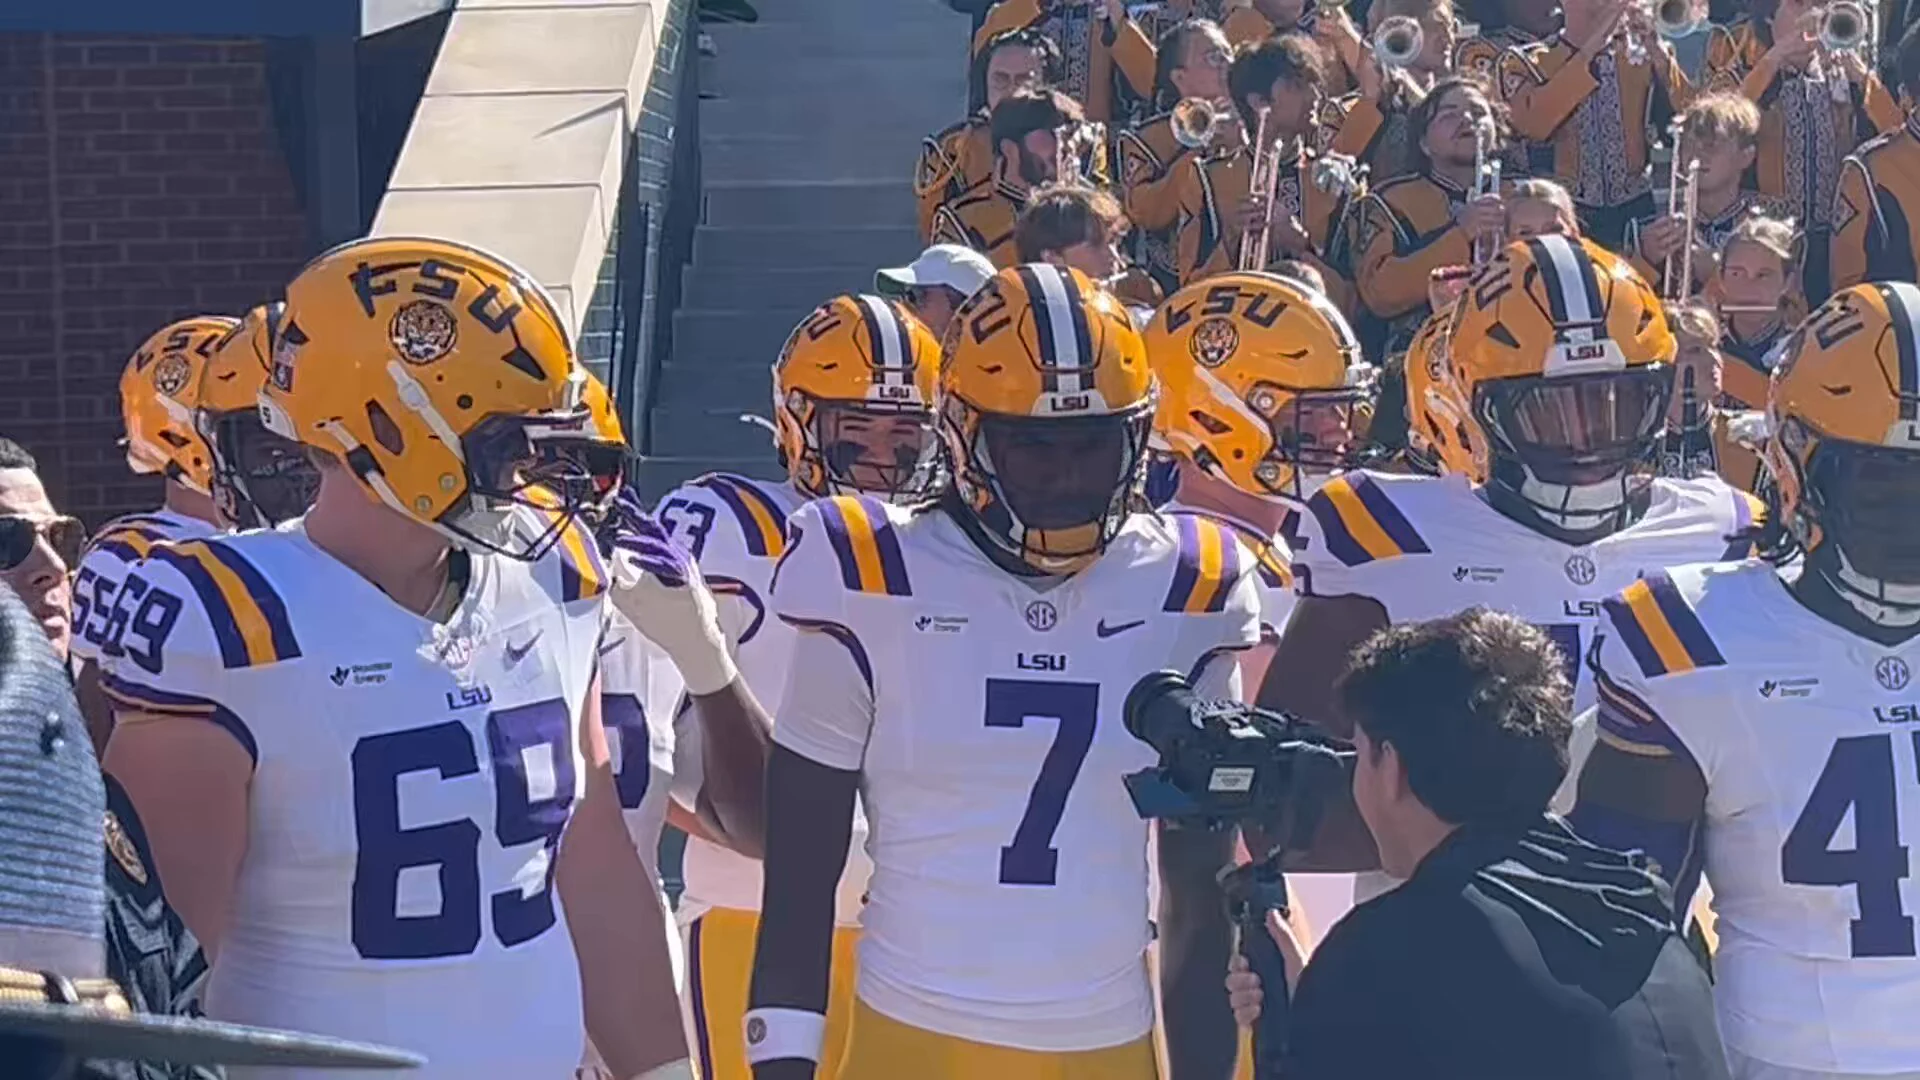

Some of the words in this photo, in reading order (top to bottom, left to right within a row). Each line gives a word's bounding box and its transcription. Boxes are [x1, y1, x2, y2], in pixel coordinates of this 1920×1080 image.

[352, 258, 522, 334] LSU
[1165, 285, 1288, 334] LSU
[1566, 345, 1605, 361] LSU
[879, 386, 910, 399] LSU
[1050, 395, 1090, 411] LSU
[101, 573, 184, 676] 69
[1017, 652, 1066, 671] LSU
[445, 684, 492, 711] LSU
[984, 677, 1101, 886] 7
[351, 697, 576, 960] 69
[1781, 730, 1920, 958] 4
